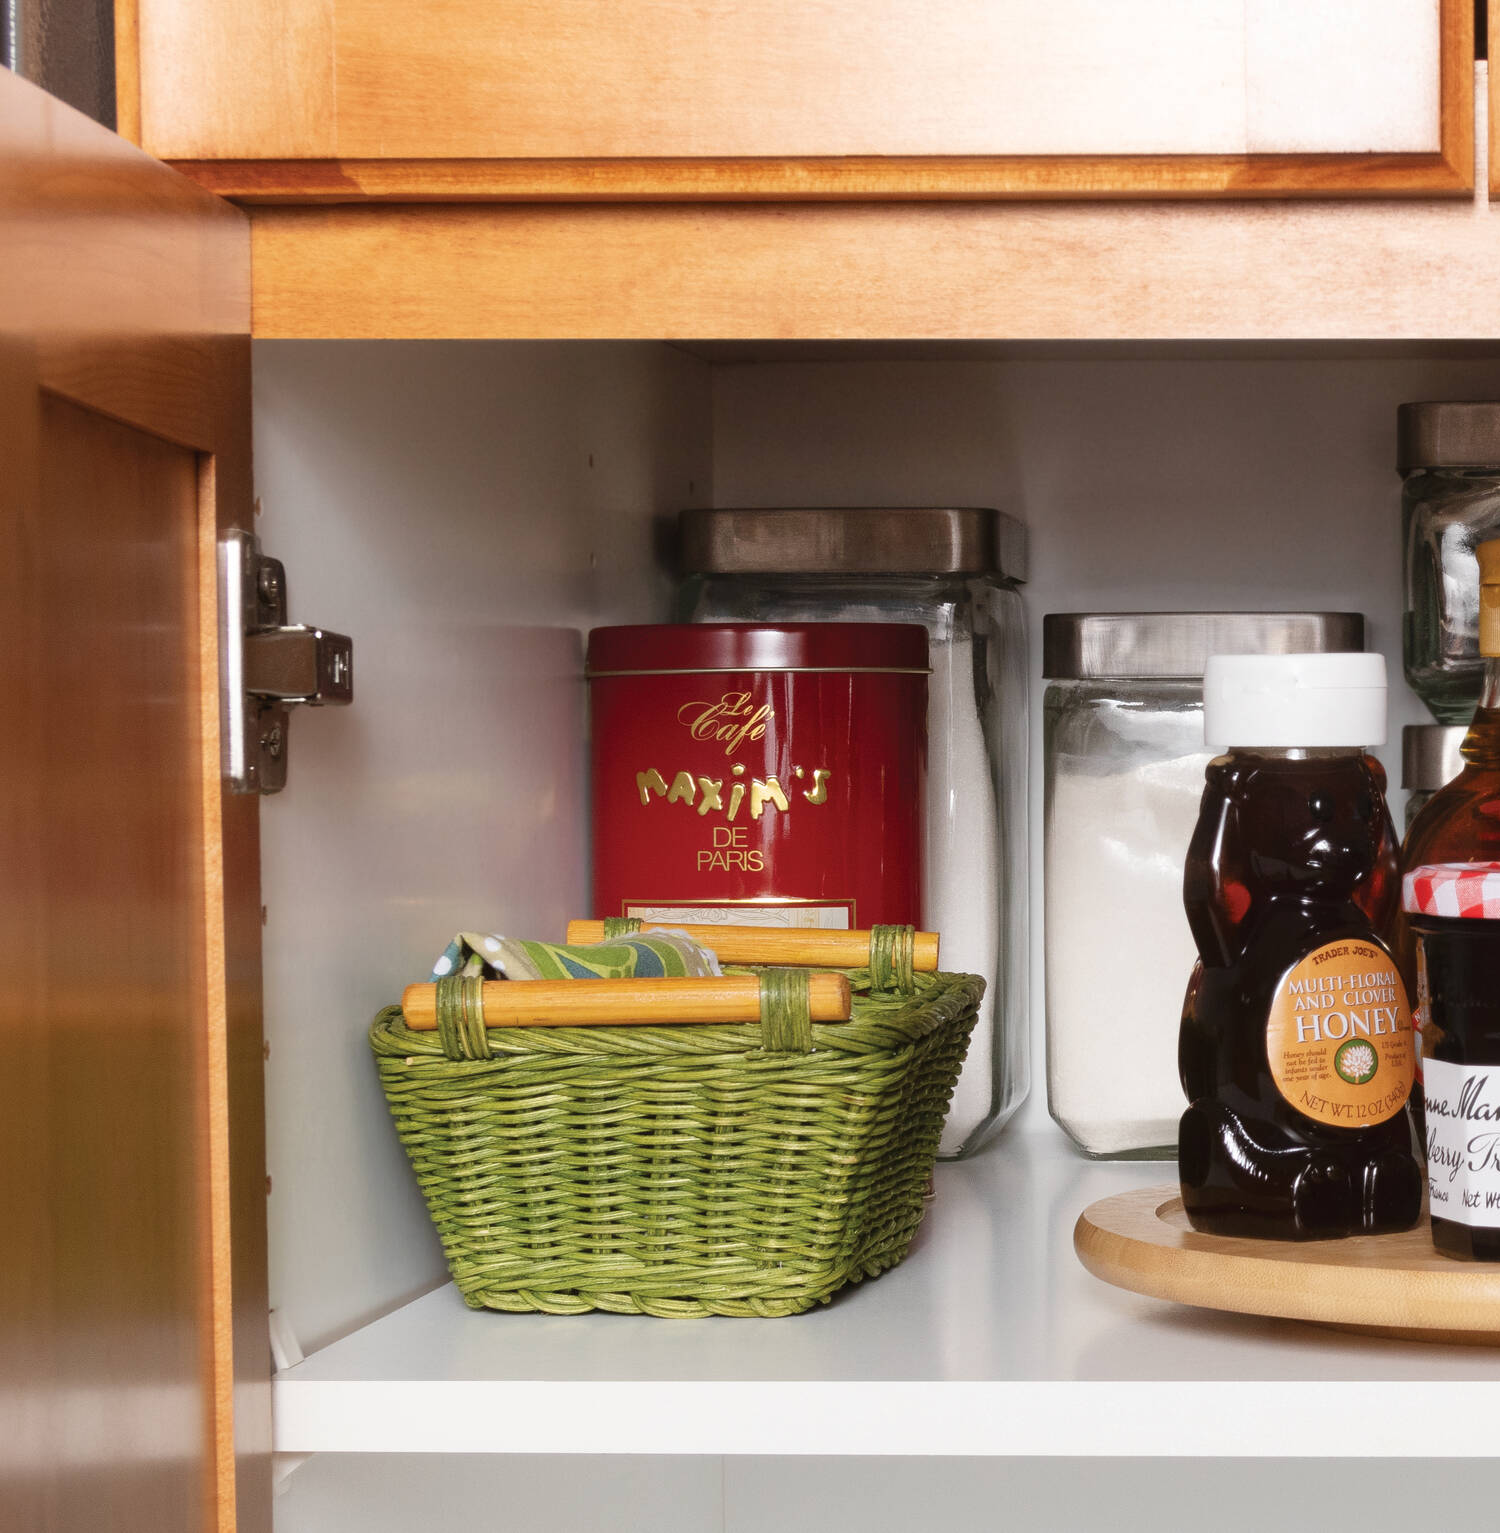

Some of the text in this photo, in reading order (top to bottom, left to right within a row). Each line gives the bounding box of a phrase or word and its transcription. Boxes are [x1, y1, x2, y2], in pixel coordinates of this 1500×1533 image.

[721, 691, 753, 717] Le
[677, 701, 775, 755] Café
[713, 827, 748, 848] DE
[697, 850, 764, 872] PARIS
[1312, 946, 1349, 966] TRADER
[1288, 971, 1398, 995] MULTI-FLORAL
[1294, 987, 1396, 1012] AND CLOVER
[1296, 1006, 1400, 1043] HONEY
[1300, 1090, 1329, 1113] NET
[1357, 1104, 1367, 1118] 12
[1367, 1099, 1385, 1116] OZ
[1424, 1097, 1450, 1117] nne
[1427, 1125, 1465, 1183] berry
[1462, 1187, 1481, 1208] Net
